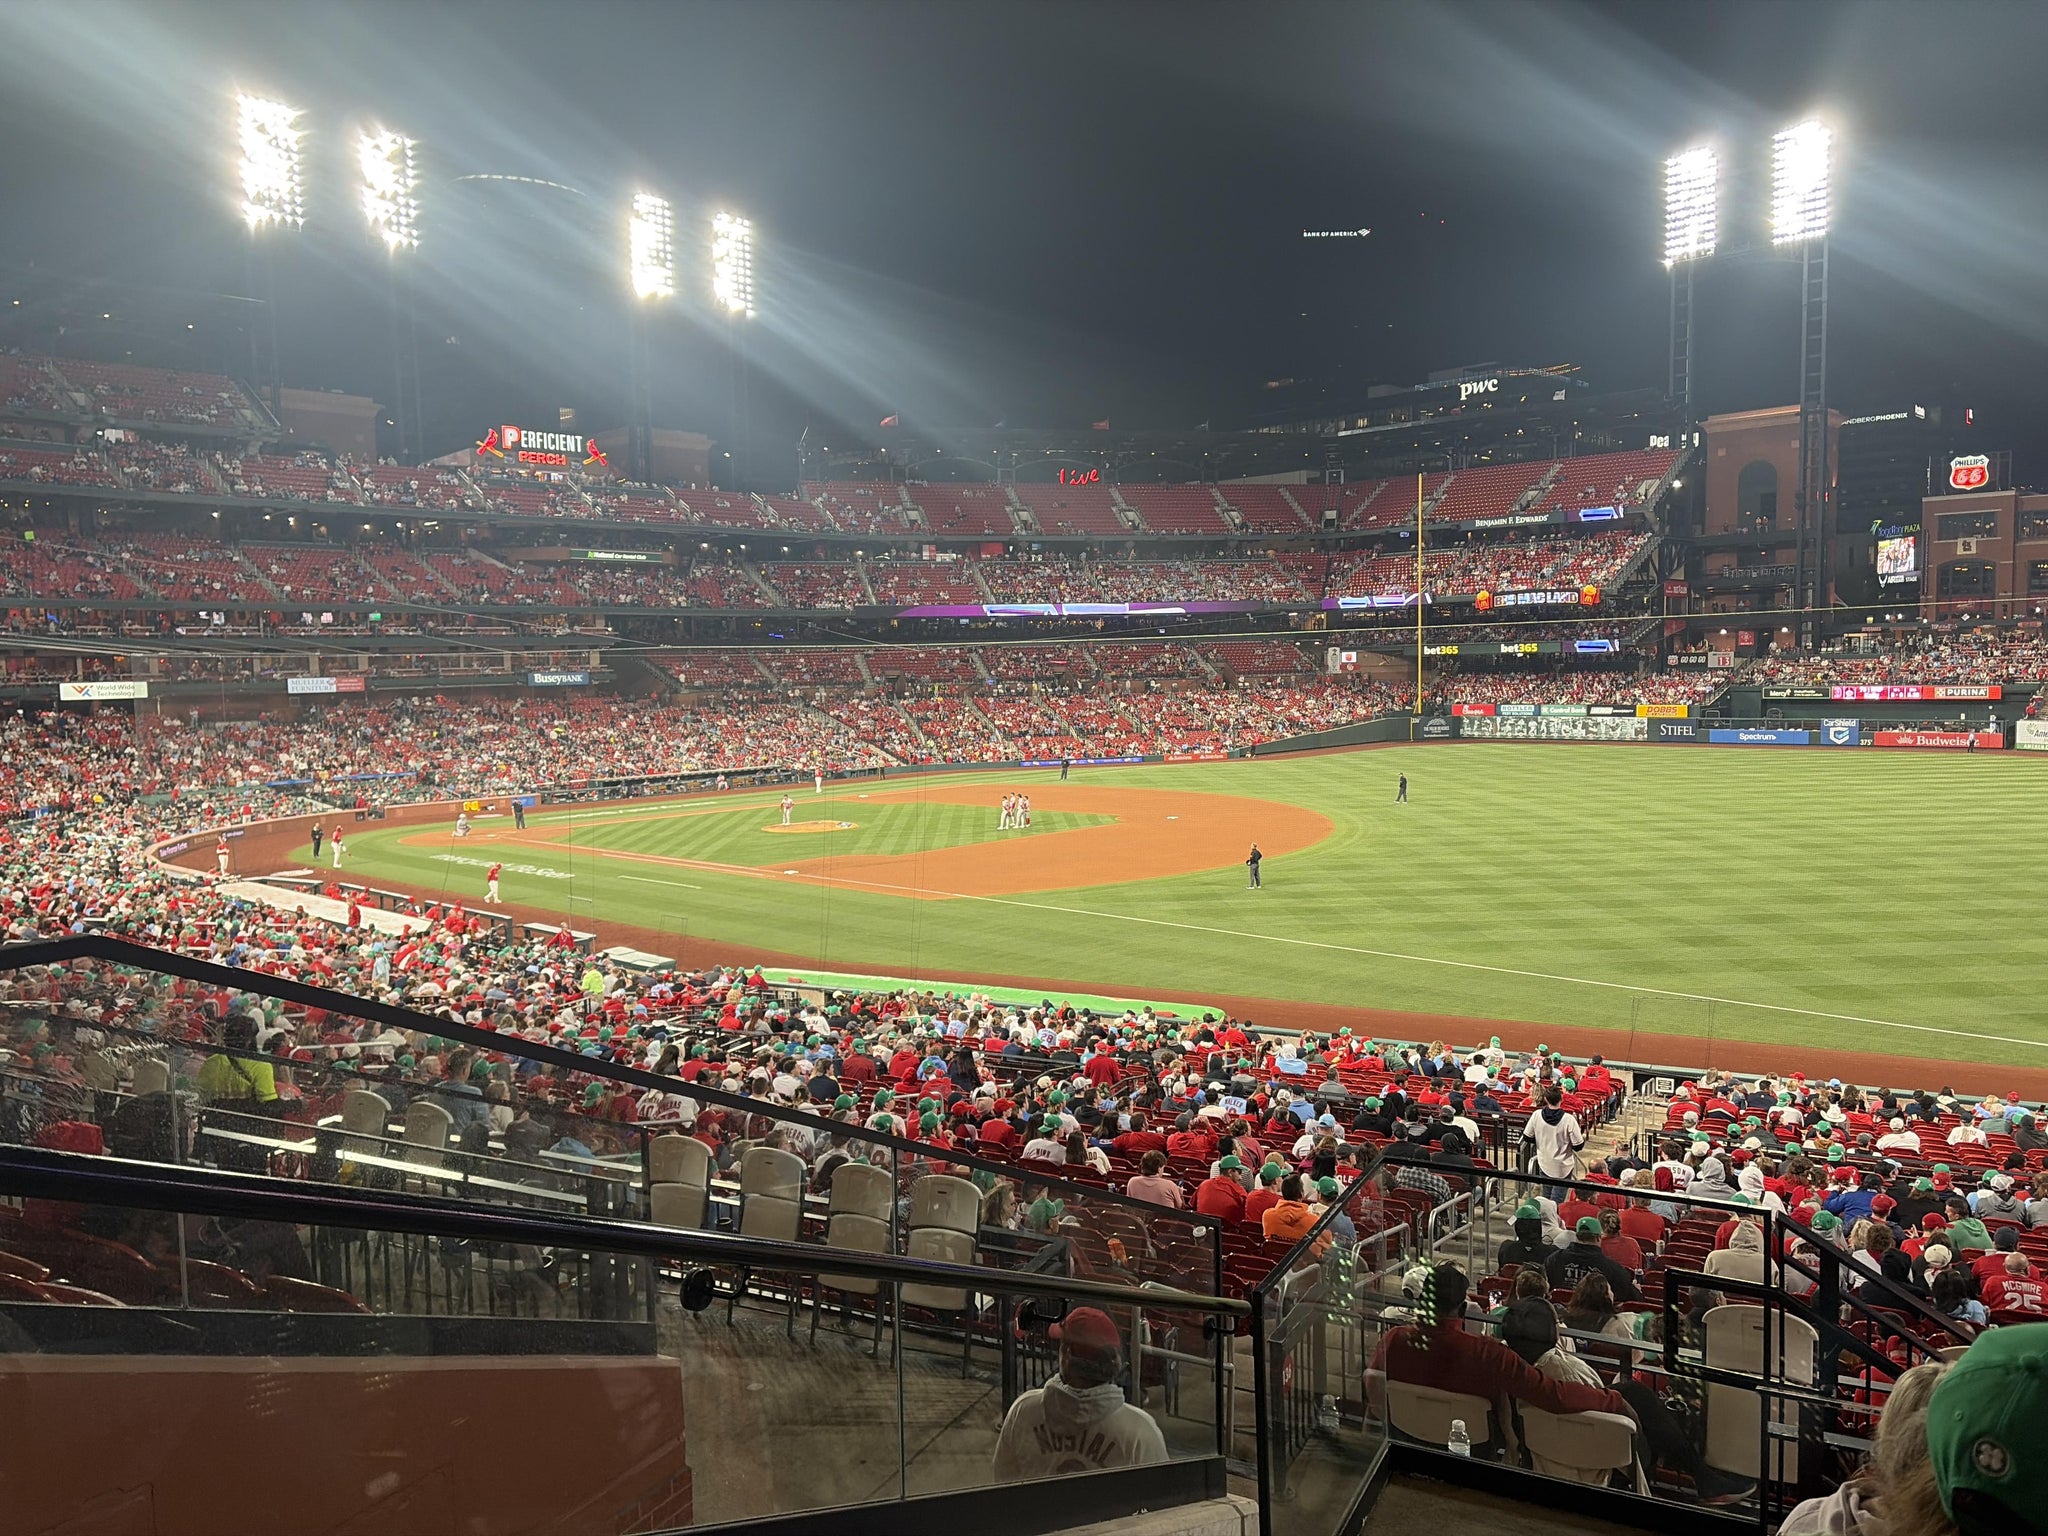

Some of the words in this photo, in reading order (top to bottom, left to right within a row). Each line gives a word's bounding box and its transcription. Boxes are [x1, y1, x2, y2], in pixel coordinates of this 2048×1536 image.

[1460, 378, 1499, 401] pwc
[1841, 412, 1908, 426] ANDBERGPHOENIX
[501, 425, 582, 452] PERFICIENT
[518, 450, 567, 466] PERCH
[1955, 458, 1985, 467] PHILLIPS
[1956, 468, 1984, 484] 66
[1475, 518, 1507, 527] BENJAMIN
[1515, 514, 1549, 524] EDWARDS
[1904, 523, 1920, 533] PLAZA
[1546, 591, 1579, 604] LAND
[1423, 646, 1459, 655] bet365
[1500, 643, 1538, 653] bet365
[1947, 688, 1987, 697] PURINA
[1550, 706, 1571, 714] Central
[1823, 719, 1856, 727] CarShield
[1660, 724, 1696, 736] STIFEL
[1739, 733, 1773, 741] Spectrum
[1041, 1033, 1054, 1044] 28
[2002, 1280, 2043, 1296] MCGWIRE
[2003, 1292, 2042, 1314] 25
